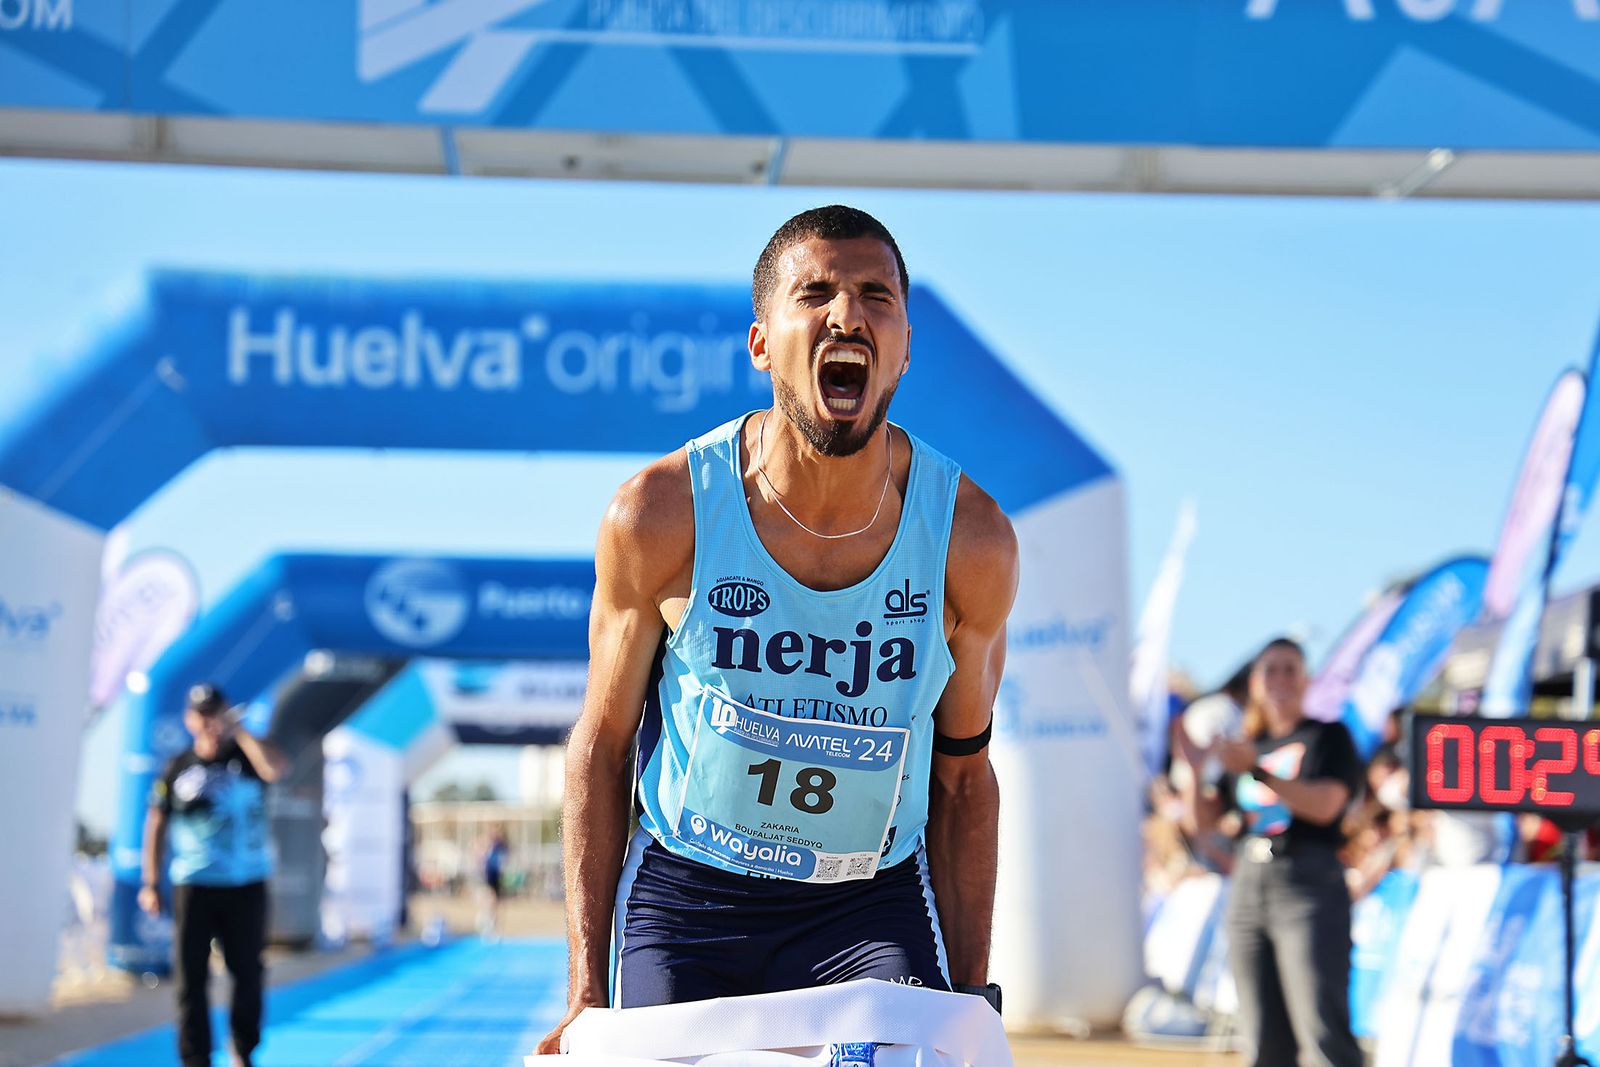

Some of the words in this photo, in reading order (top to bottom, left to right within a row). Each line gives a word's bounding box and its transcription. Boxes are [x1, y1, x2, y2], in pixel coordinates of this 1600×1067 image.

[228, 309, 521, 389] Huelva
[711, 585, 768, 611] TROPS
[883, 578, 928, 619] als
[711, 620, 917, 698] nerja
[743, 693, 888, 728] ATLETISMO
[734, 714, 780, 742] HUELVA
[785, 733, 851, 753] AVATEL
[747, 758, 837, 815] 18
[710, 823, 802, 867] Wayalia
[734, 823, 785, 842] BOUFALJAT
[786, 836, 823, 849] SEDDYQ
[760, 821, 800, 834] ZAKARIA
